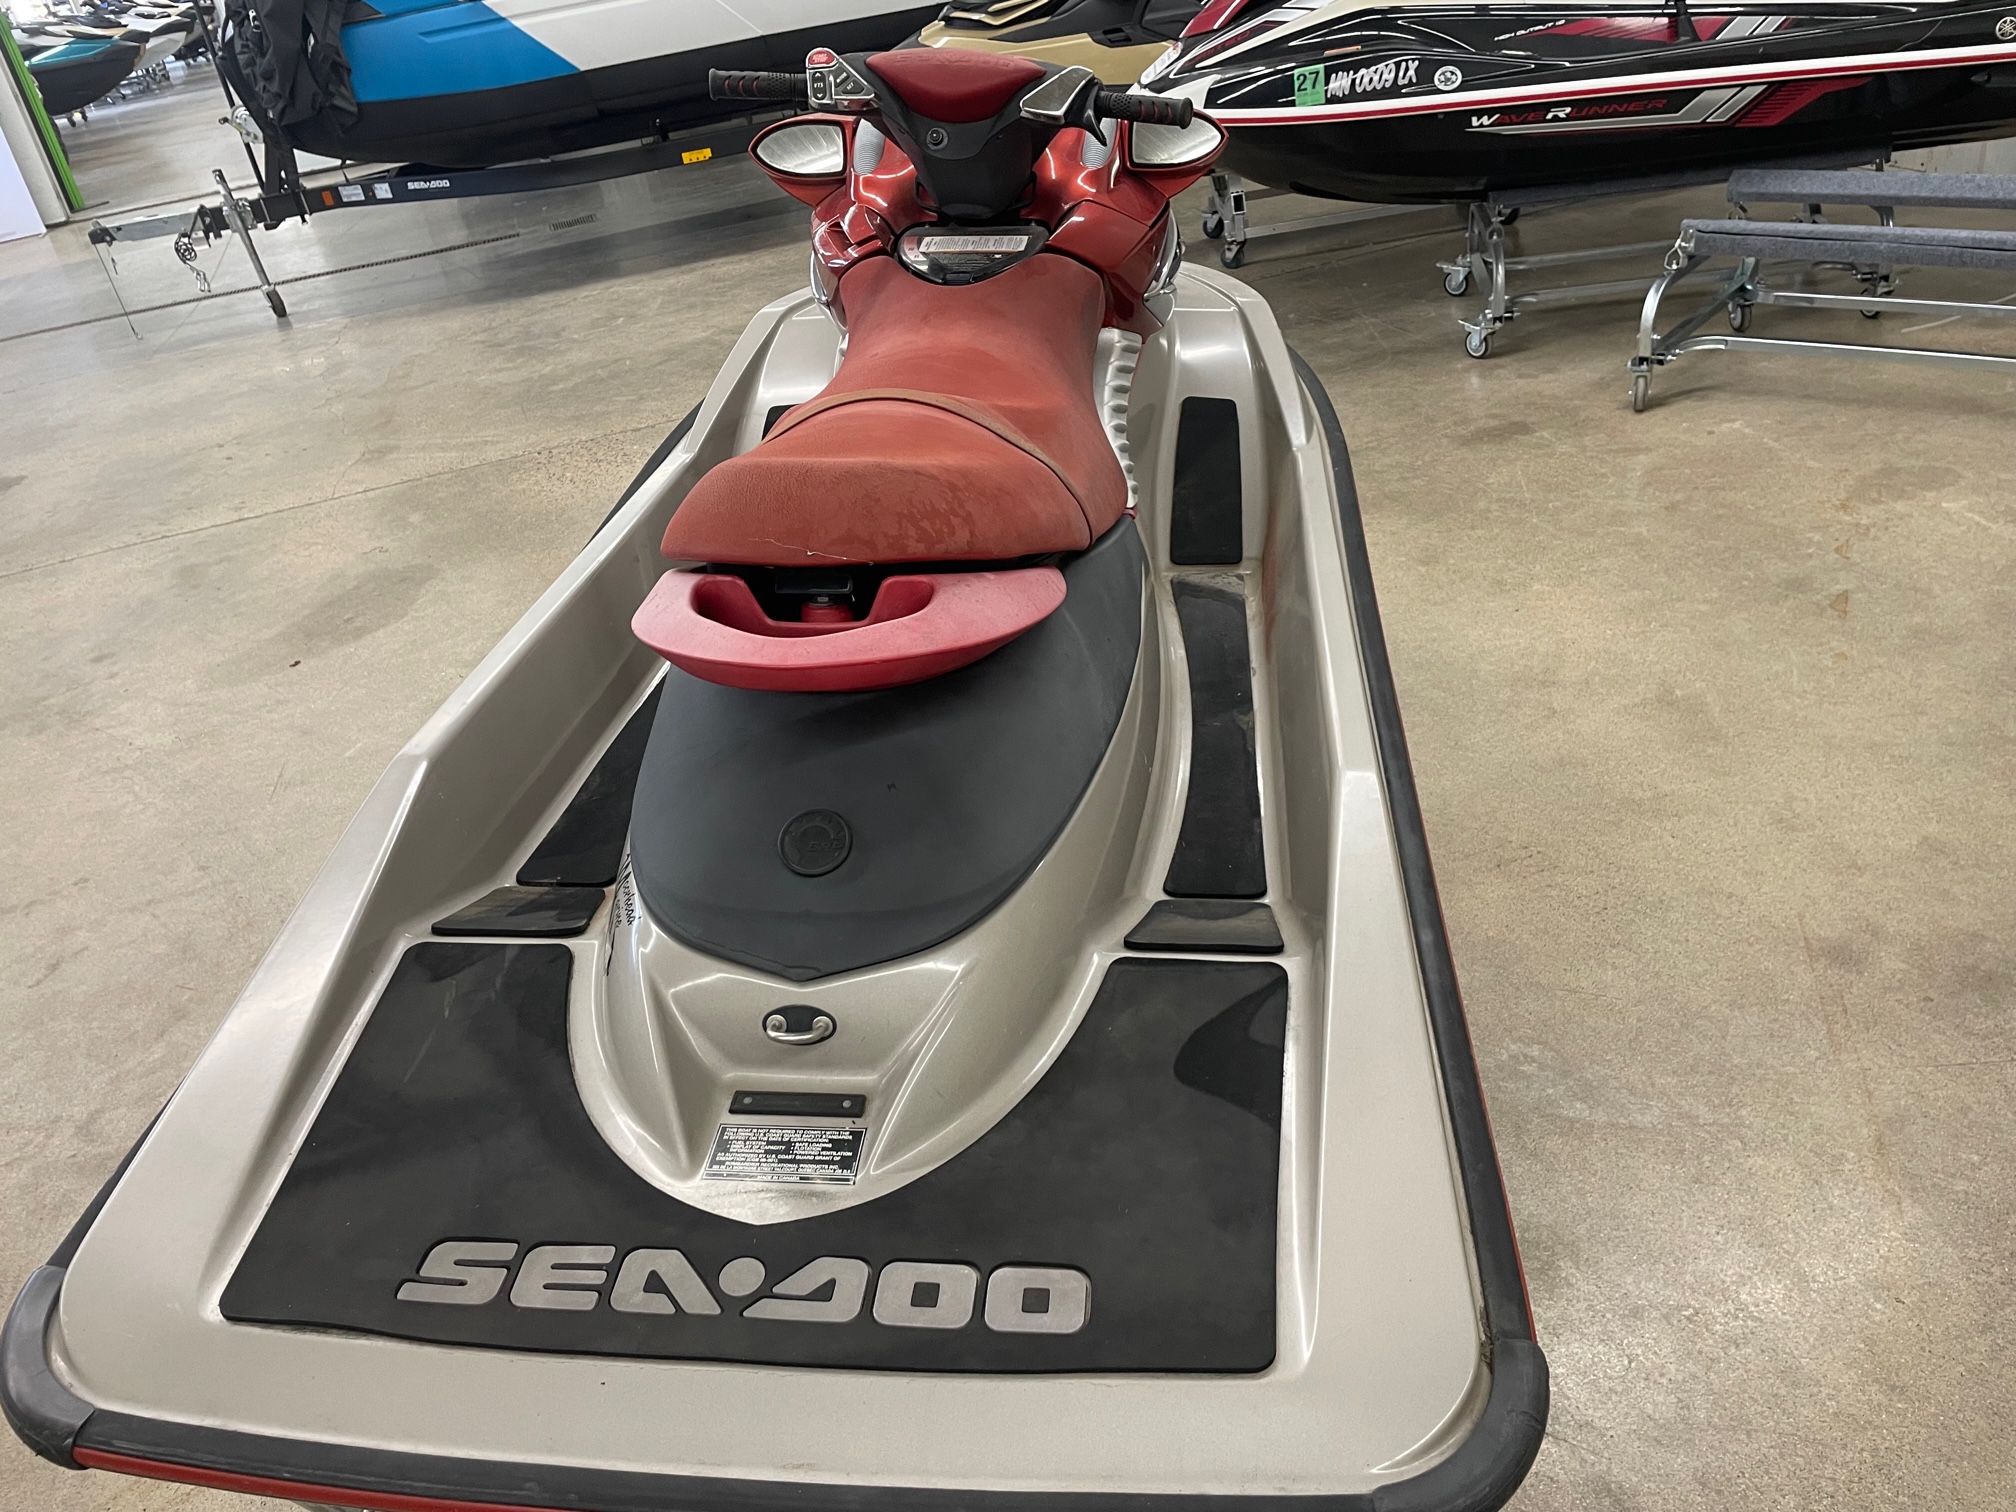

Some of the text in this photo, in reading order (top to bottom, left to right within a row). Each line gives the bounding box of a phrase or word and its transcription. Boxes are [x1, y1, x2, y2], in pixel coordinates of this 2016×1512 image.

[1296, 70, 1320, 92] 27
[1326, 69, 1354, 98] MN
[1397, 59, 1419, 86] LX
